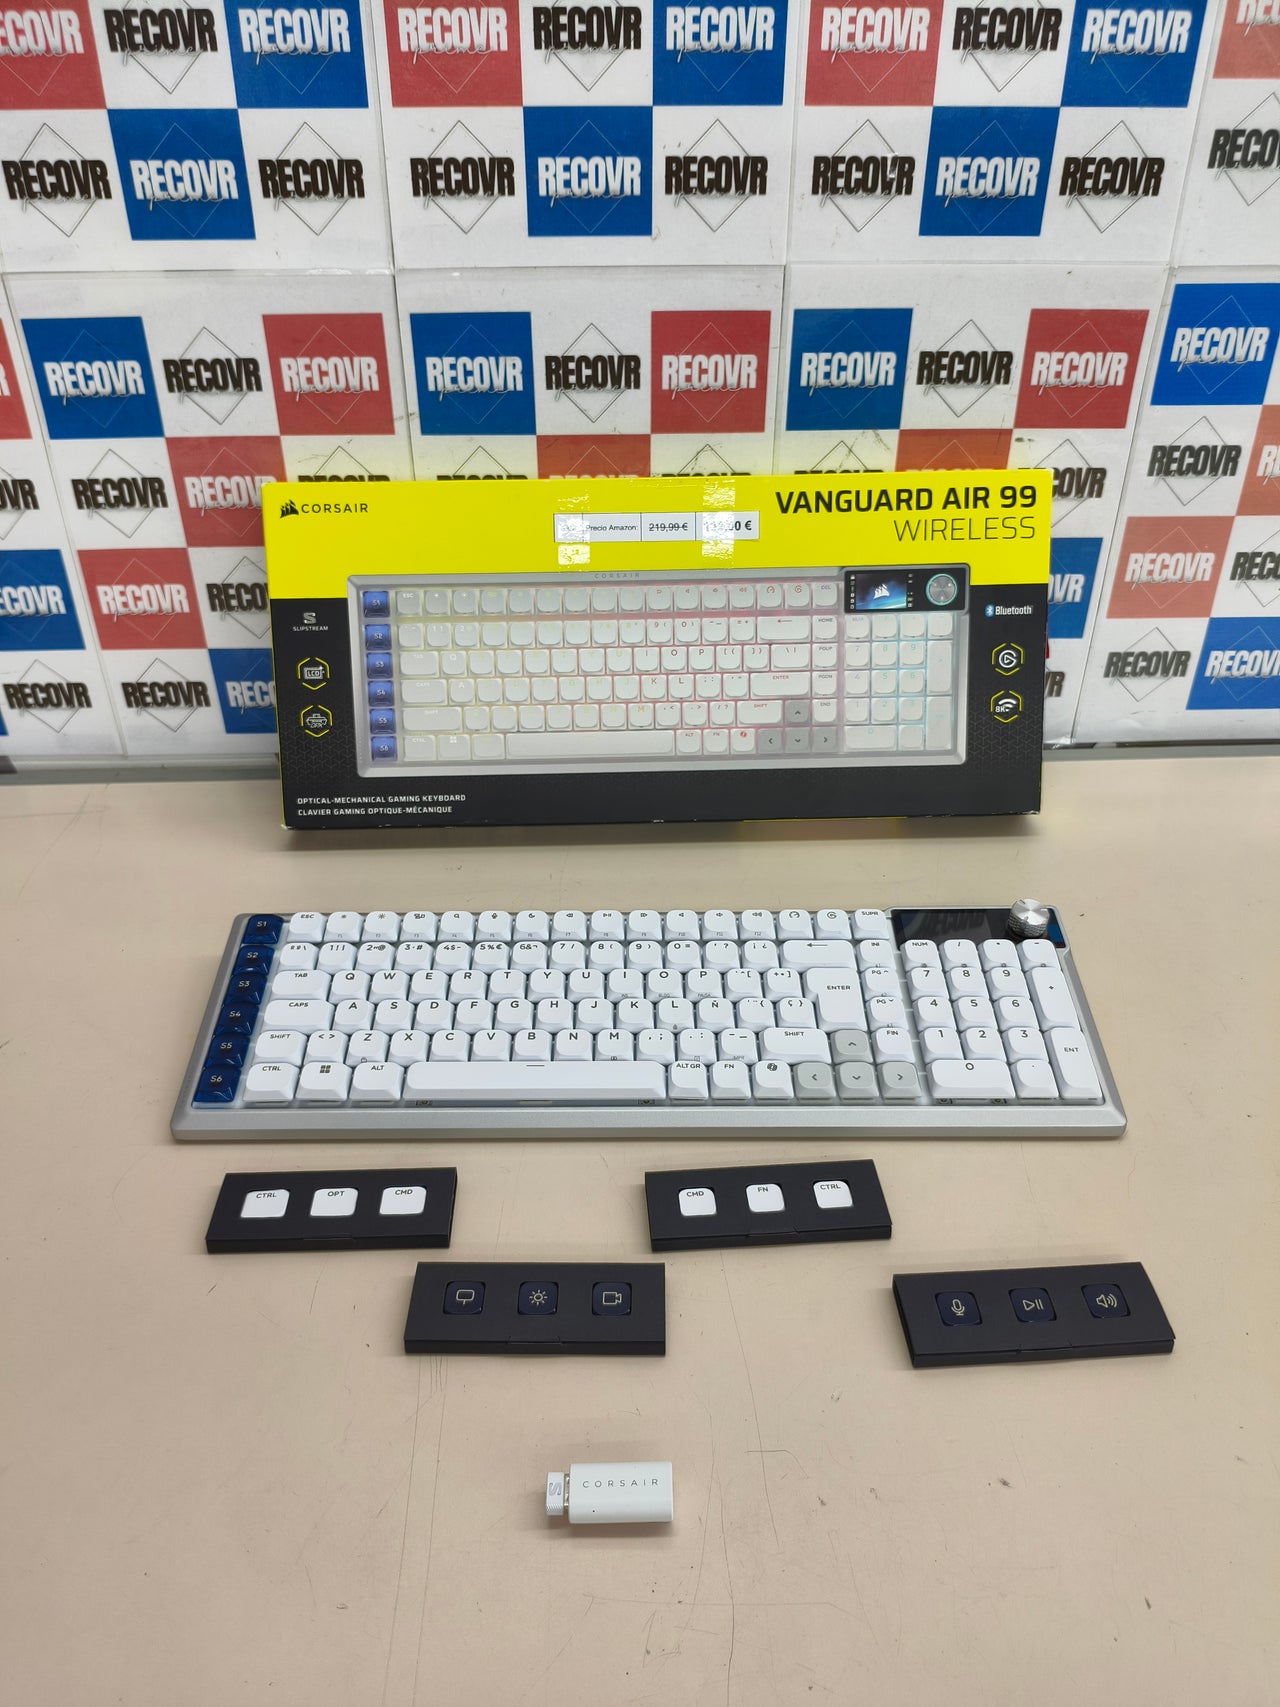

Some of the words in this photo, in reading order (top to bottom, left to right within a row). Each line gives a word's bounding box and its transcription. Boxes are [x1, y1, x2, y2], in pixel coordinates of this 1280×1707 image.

[0, 9, 84, 54] ECOVR
[104, 9, 218, 53] RECOVR
[238, 8, 351, 53] RECOVR
[397, 7, 507, 52] RECOVR
[533, 6, 642, 50] RECOVR
[666, 6, 775, 51] RECOVR
[821, 7, 930, 52] RECOVR
[952, 7, 1062, 51] RECOVR
[1081, 9, 1192, 53] RECOVR
[1207, 129, 1280, 168] RECO
[1, 160, 112, 200] RECOVR
[129, 159, 239, 200] RECOVR
[258, 159, 365, 199] RECOVR
[410, 157, 515, 196] RECOVR
[537, 156, 641, 196] RECOVR
[664, 155, 768, 195] RECOVR
[811, 156, 915, 195] RECOVR
[935, 156, 1040, 197] RECOVR
[1059, 157, 1165, 196] RECOVR
[1170, 326, 1270, 363] RECOVR
[43, 359, 146, 396] RECOVR
[162, 358, 263, 392] RECOVR
[279, 357, 379, 392] RECOVR
[425, 356, 523, 392] RECOVR
[544, 355, 641, 390] RECOVR
[661, 354, 757, 390] RECOVR
[800, 351, 897, 387] RECOVR
[916, 350, 1013, 386] RECOVR
[1030, 351, 1128, 387] RECOVR
[1147, 445, 1242, 477] RECOVR
[71, 477, 168, 510] RECOVR
[301, 503, 368, 513] CORSAIR
[775, 488, 933, 514] VANGUARD
[942, 487, 990, 510] AIR
[1000, 486, 1037, 509] 99
[893, 516, 1035, 541] WIRELESS
[1125, 553, 1215, 582] RECOVR
[0, 584, 66, 615] ECOVR
[96, 583, 190, 614] RECOVR
[206, 583, 268, 612] RECO
[995, 606, 1032, 616] Bluetooth
[1104, 651, 1191, 678] RECOVR
[3, 683, 92, 709] RECOVR
[121, 681, 211, 708] RECOVR
[298, 796, 386, 804] OPTICAL-MECHANICAL
[422, 794, 466, 802] KEYBOARD
[298, 808, 332, 816] CLAVIER
[368, 806, 452, 814] OPTIQUE-MÉCANIQUE
[583, 1479, 658, 1488] CORSAIR
